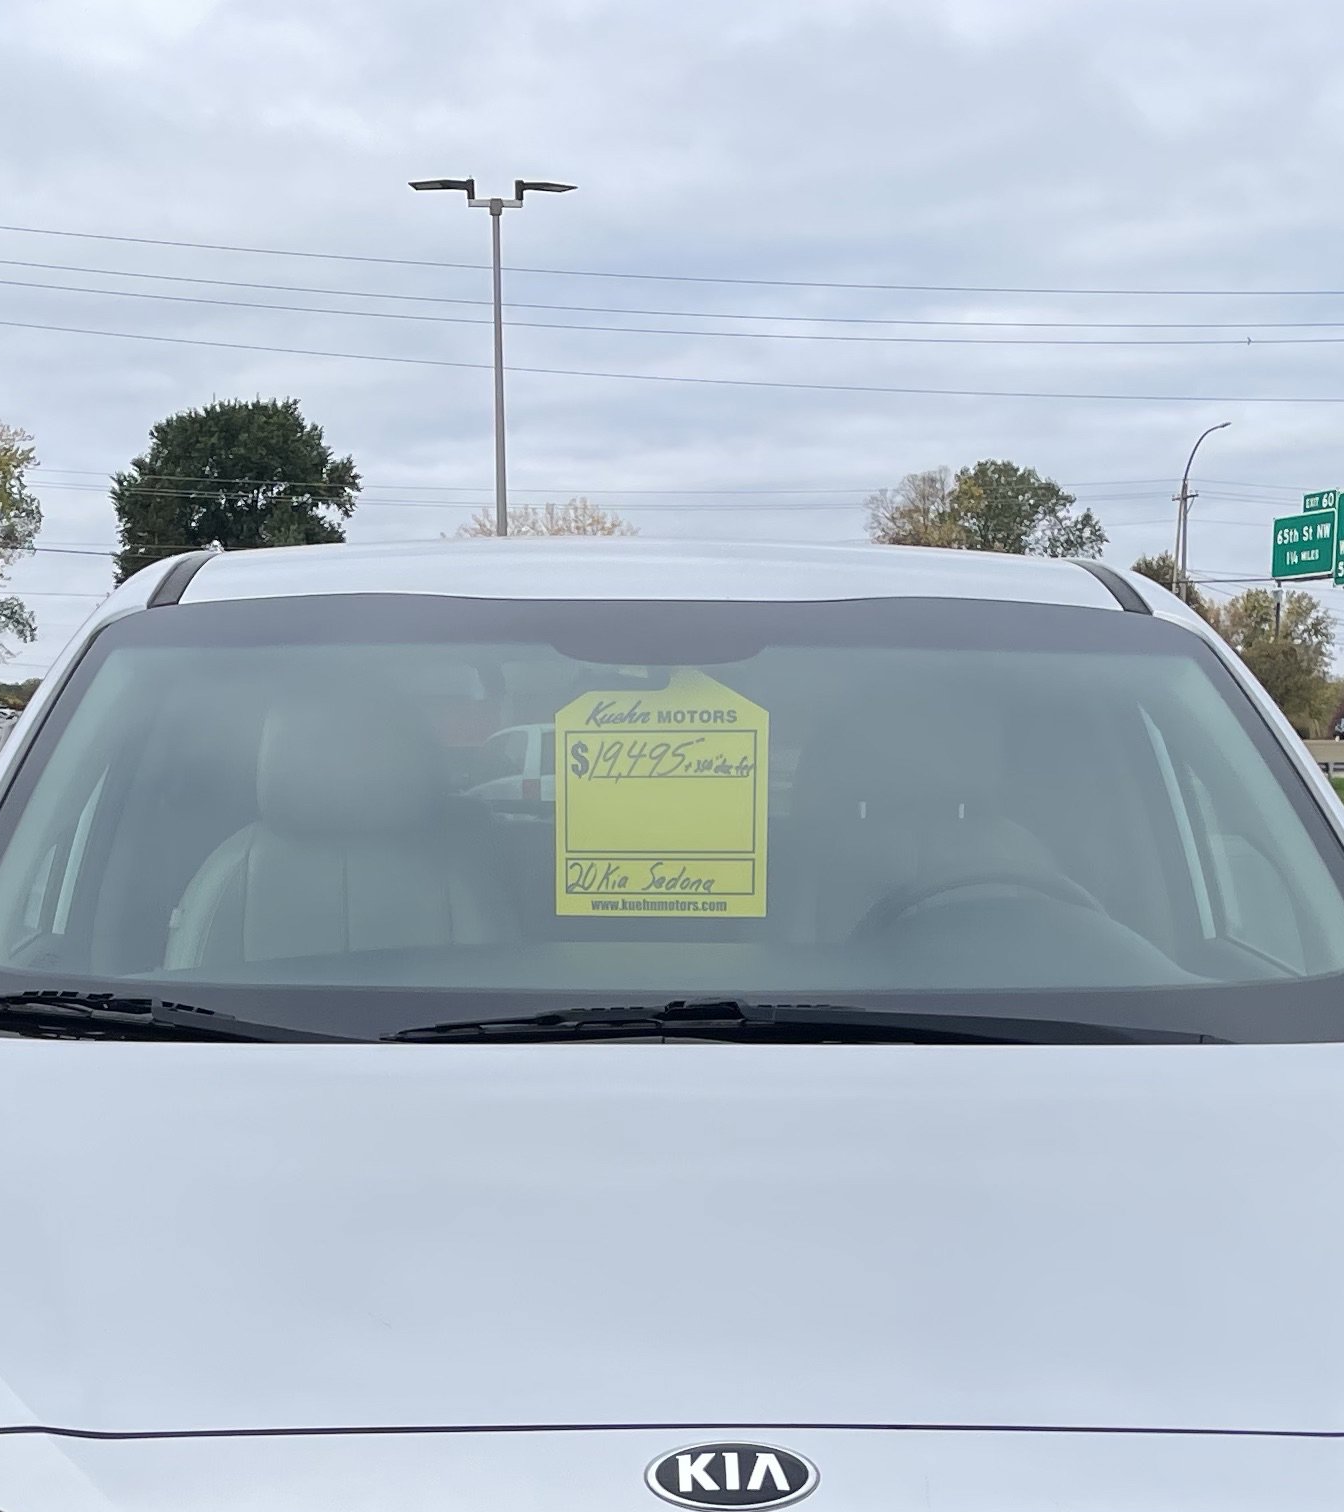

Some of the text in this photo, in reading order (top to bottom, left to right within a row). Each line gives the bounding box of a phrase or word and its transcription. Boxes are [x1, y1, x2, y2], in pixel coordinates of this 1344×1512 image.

[1321, 492, 1335, 508] 60
[1276, 522, 1331, 545] 65th St NW
[585, 699, 738, 728] Kuehn MOTORS
[567, 862, 716, 894] 20 Kia Sedona
[591, 898, 728, 912] www.kuehnmotors.com
[676, 1452, 791, 1493] KIA
